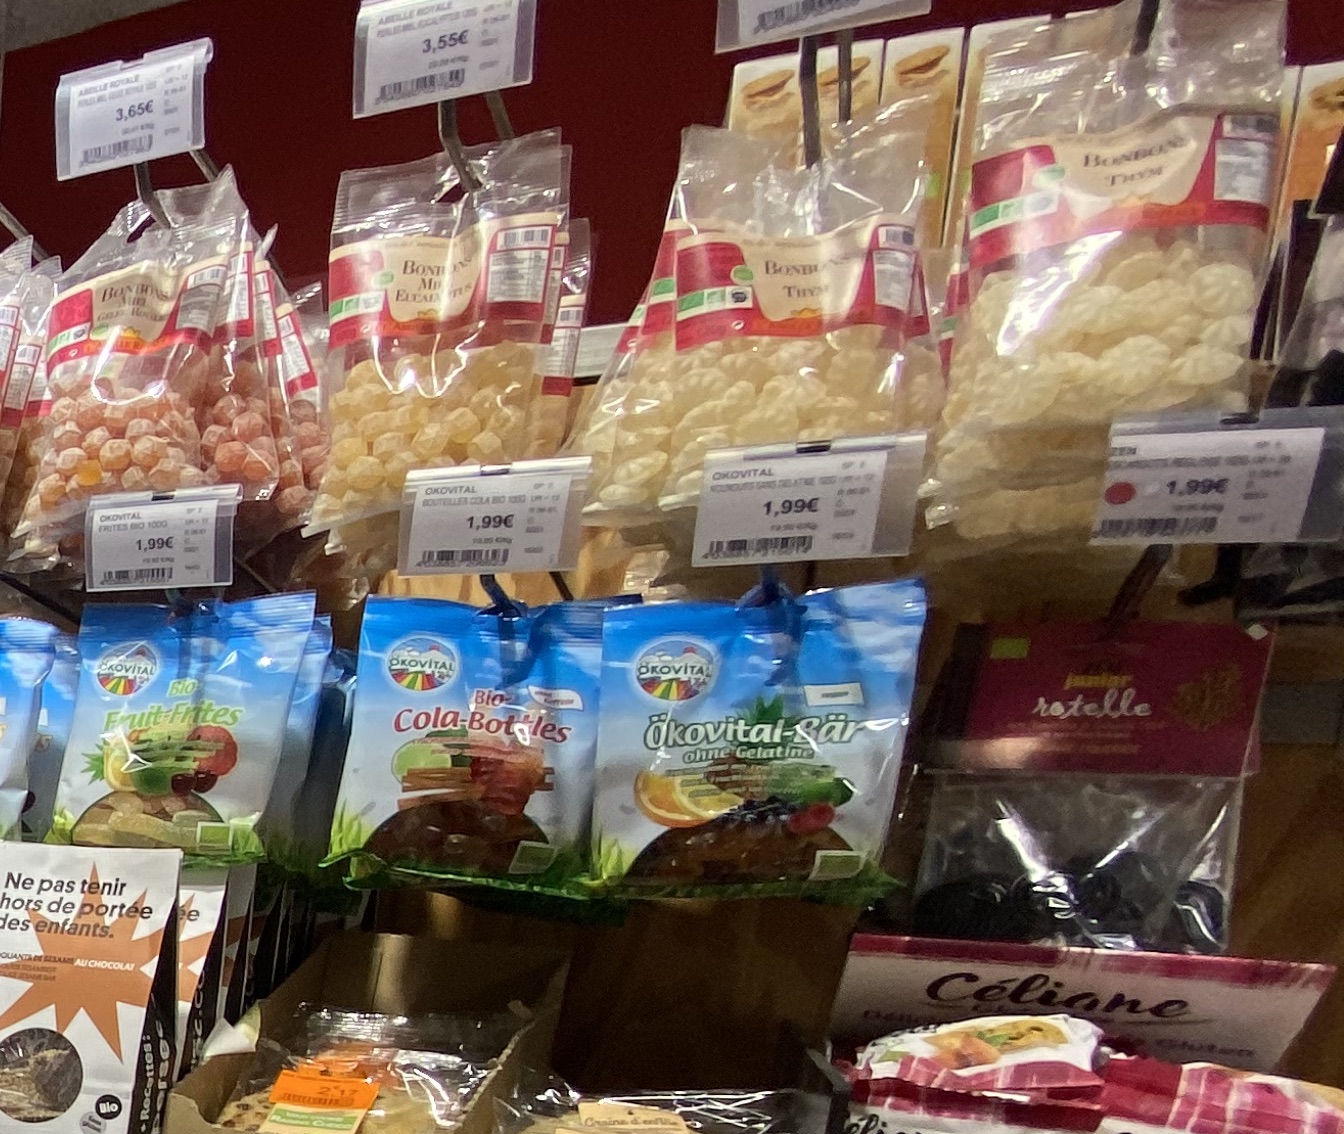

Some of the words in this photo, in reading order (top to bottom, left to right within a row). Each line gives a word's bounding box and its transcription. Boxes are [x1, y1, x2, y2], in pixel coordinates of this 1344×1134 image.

[421, 31, 469, 54] 3,55€
[115, 101, 154, 121] 3,65€
[763, 497, 819, 516] 1,99€
[100, 512, 142, 523] OKOVITAL
[466, 514, 514, 530] 1,99€
[135, 536, 174, 552] 1,99€
[1032, 688, 1153, 719] rotelle
[393, 706, 572, 743] Cola-Bottles
[682, 746, 729, 764] ohne
[735, 744, 815, 762] Gelatine
[5, 871, 34, 891] Ne
[37, 877, 75, 896] pas
[80, 878, 126, 897] tenir
[46, 895, 75, 916] de
[78, 899, 153, 921] portée
[34, 916, 114, 938] enfants.
[75, 957, 86, 967] AU
[88, 958, 135, 971] CHOCOLAT
[925, 971, 1191, 1020] Céliane
